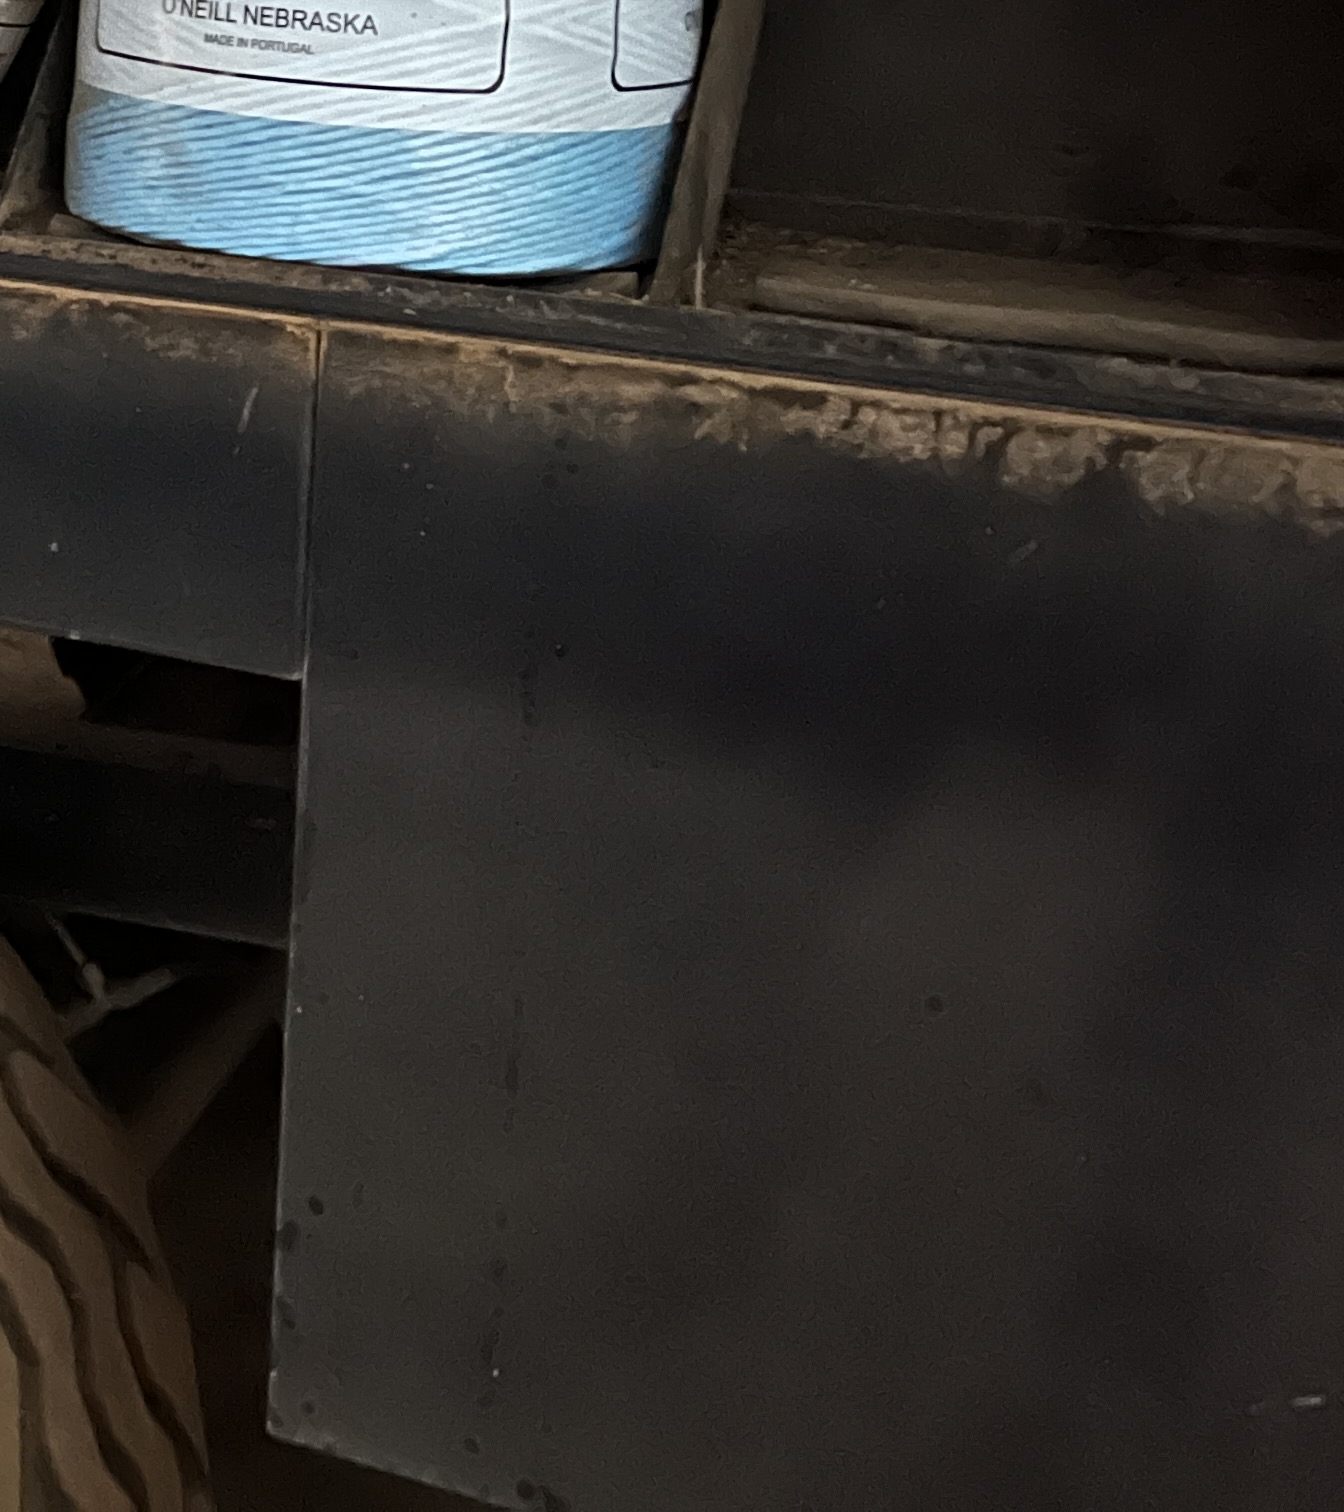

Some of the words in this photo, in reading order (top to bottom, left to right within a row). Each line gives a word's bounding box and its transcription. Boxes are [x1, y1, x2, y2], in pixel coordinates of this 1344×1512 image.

[242, 4, 380, 37] NEBRASKA
[203, 32, 233, 47] MADE
[236, 37, 249, 48] IN
[250, 39, 315, 56] PORTUGAL
